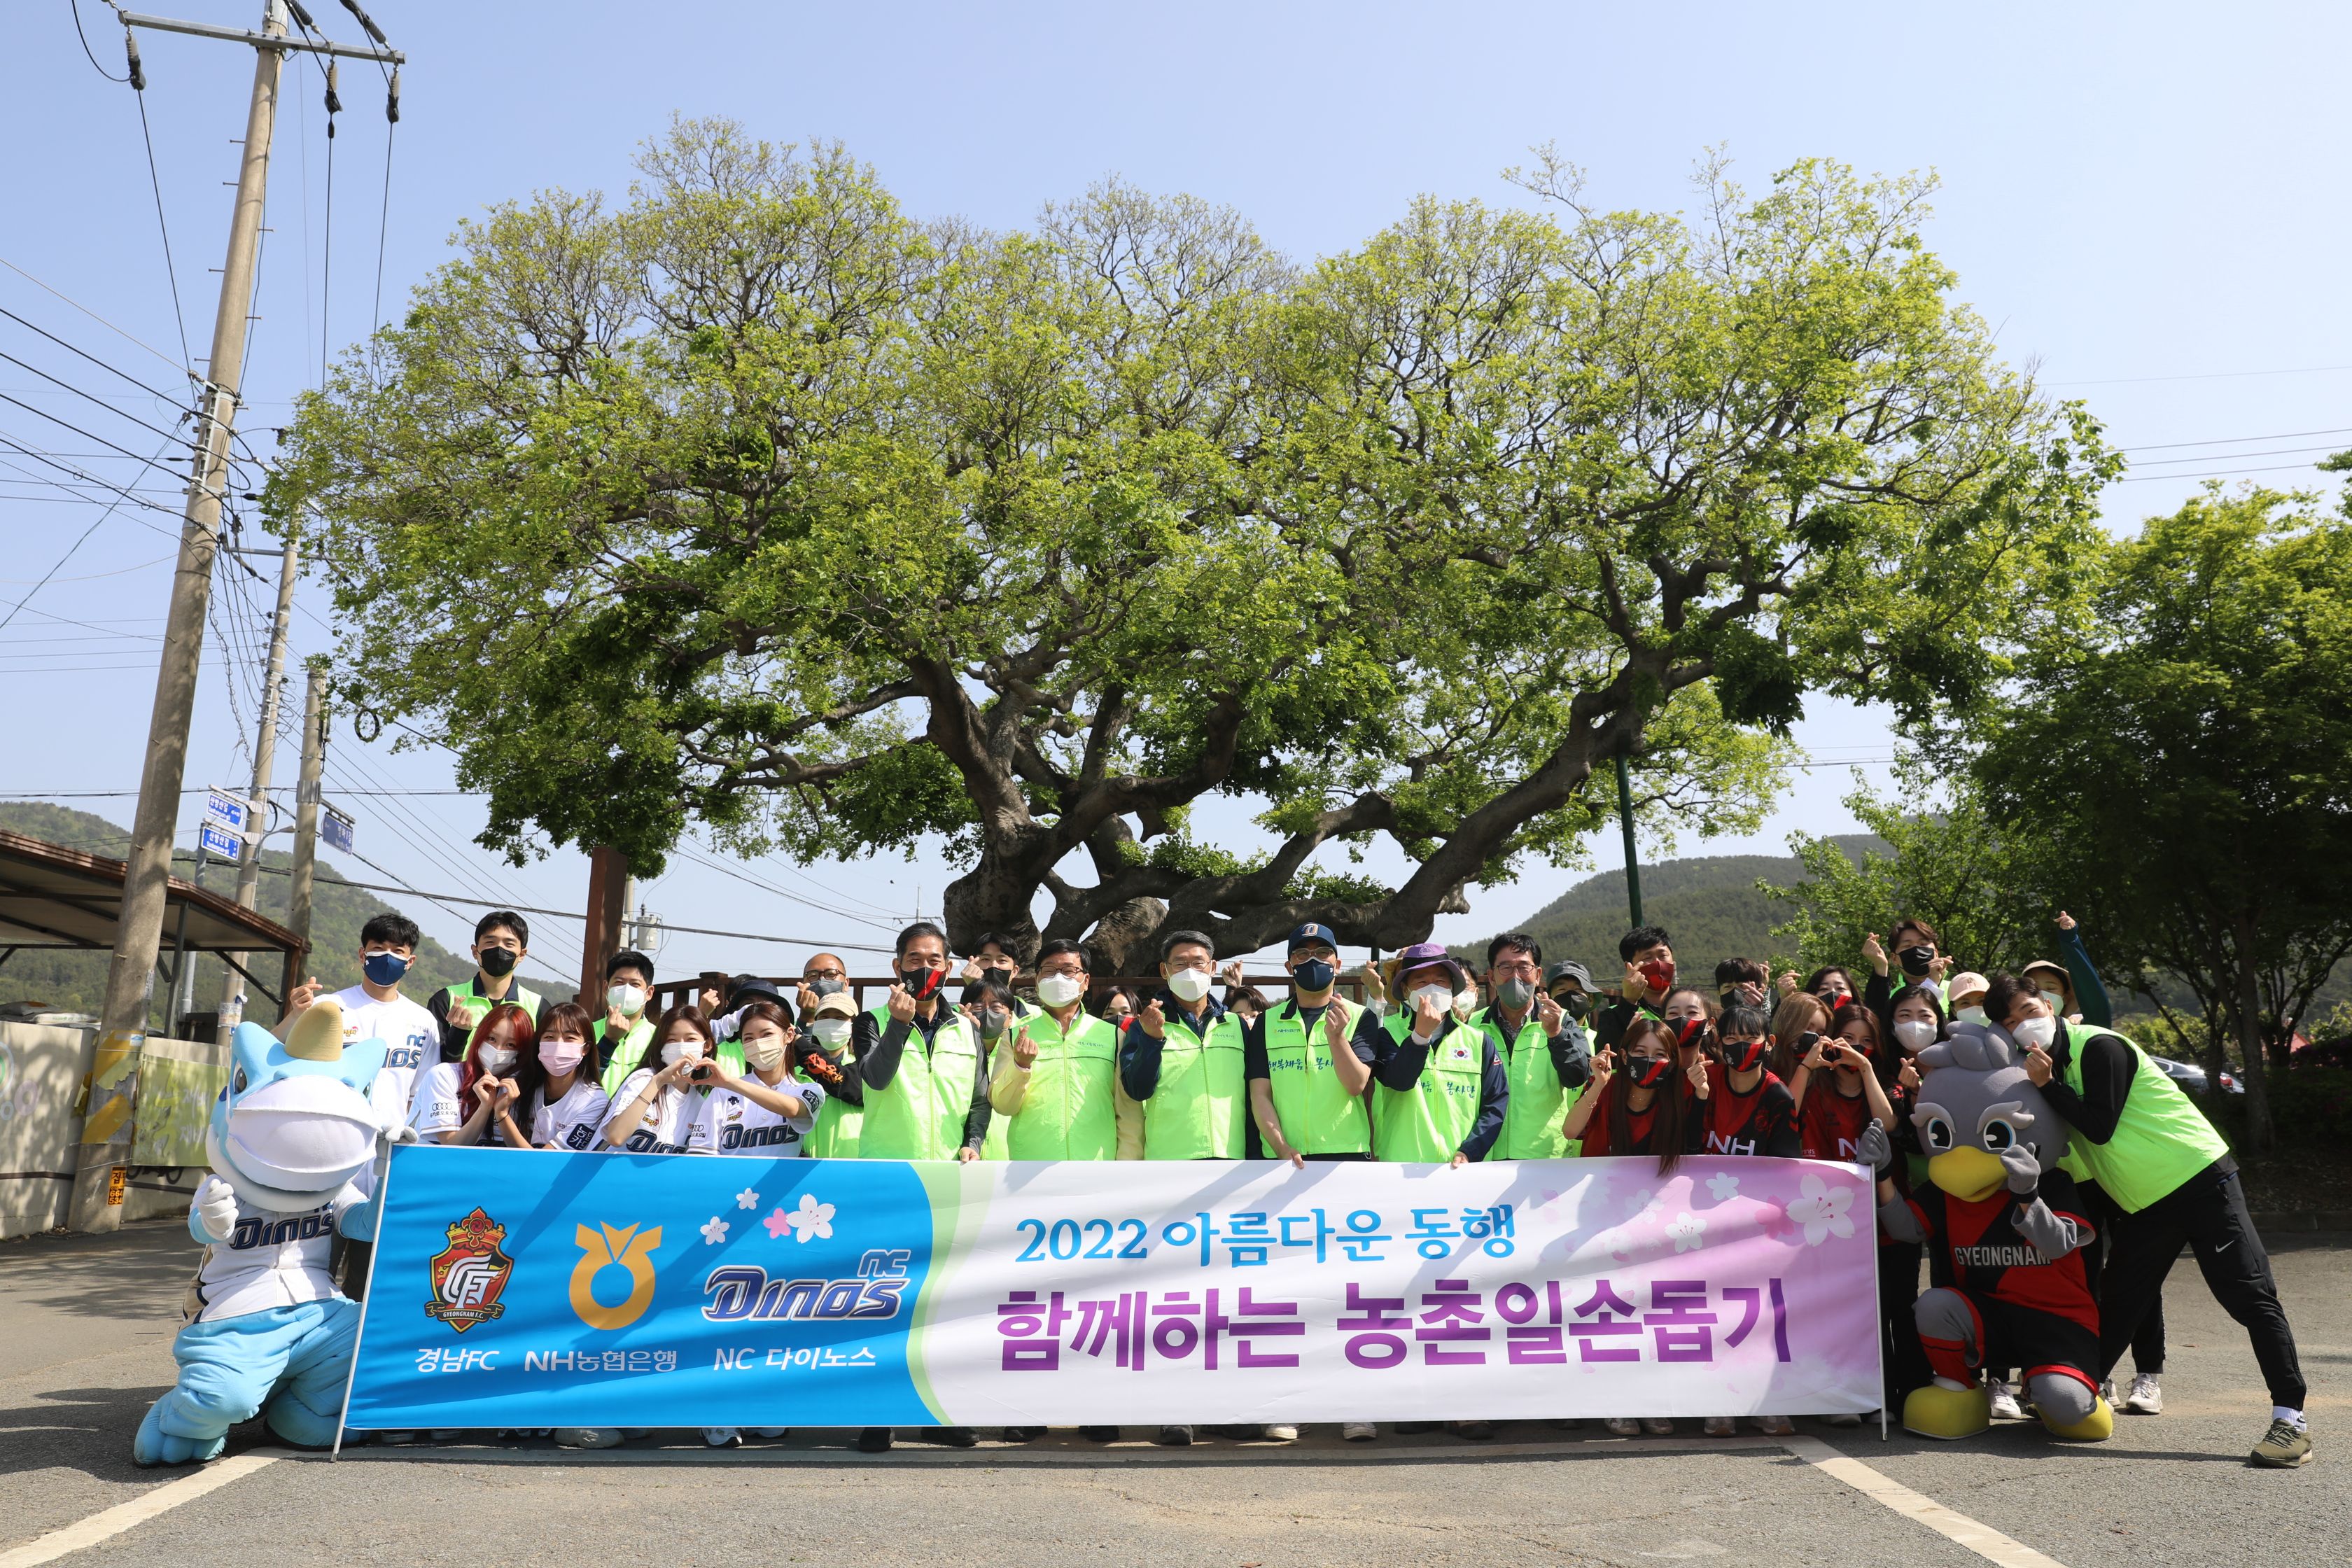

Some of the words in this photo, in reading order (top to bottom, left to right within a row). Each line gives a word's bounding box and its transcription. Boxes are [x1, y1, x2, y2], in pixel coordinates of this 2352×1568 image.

[1015, 1218, 1147, 1262] 2022
[1162, 1208, 1392, 1268] 아름다운
[1404, 1204, 1516, 1260] 동행
[997, 1287, 1306, 1371] 함께하는
[1336, 1278, 1792, 1370] 농촌일손돕기
[414, 1348, 500, 1373] 경남FC
[524, 1350, 677, 1373] NH농협은행
[714, 1348, 755, 1371] NC
[765, 1347, 876, 1371] 다이노스
